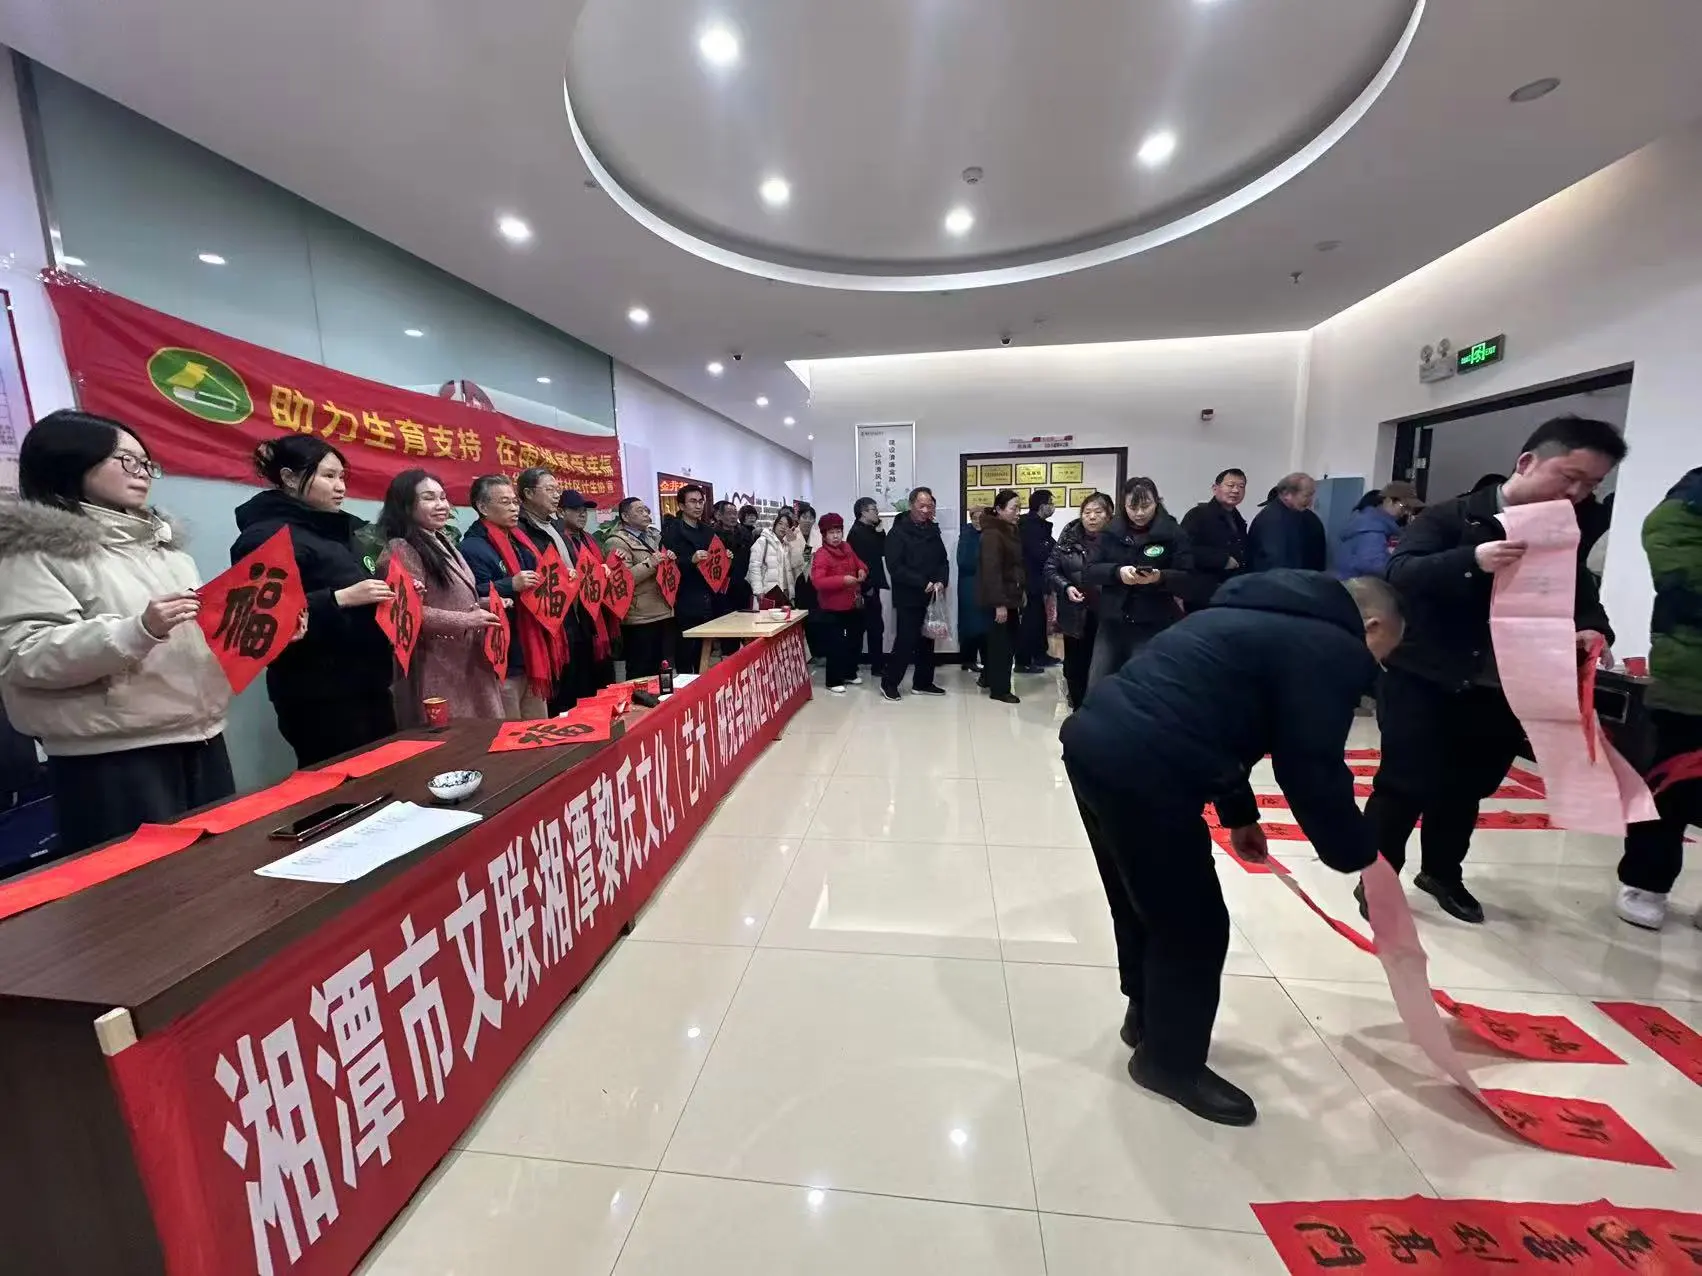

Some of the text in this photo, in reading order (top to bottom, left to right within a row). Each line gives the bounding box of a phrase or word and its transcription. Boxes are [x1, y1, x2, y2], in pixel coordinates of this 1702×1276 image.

[269, 383, 482, 463] 助力生育支持
[534, 562, 567, 618] 福
[705, 547, 723, 581] 福
[212, 562, 289, 660] 福
[508, 722, 595, 745] 福
